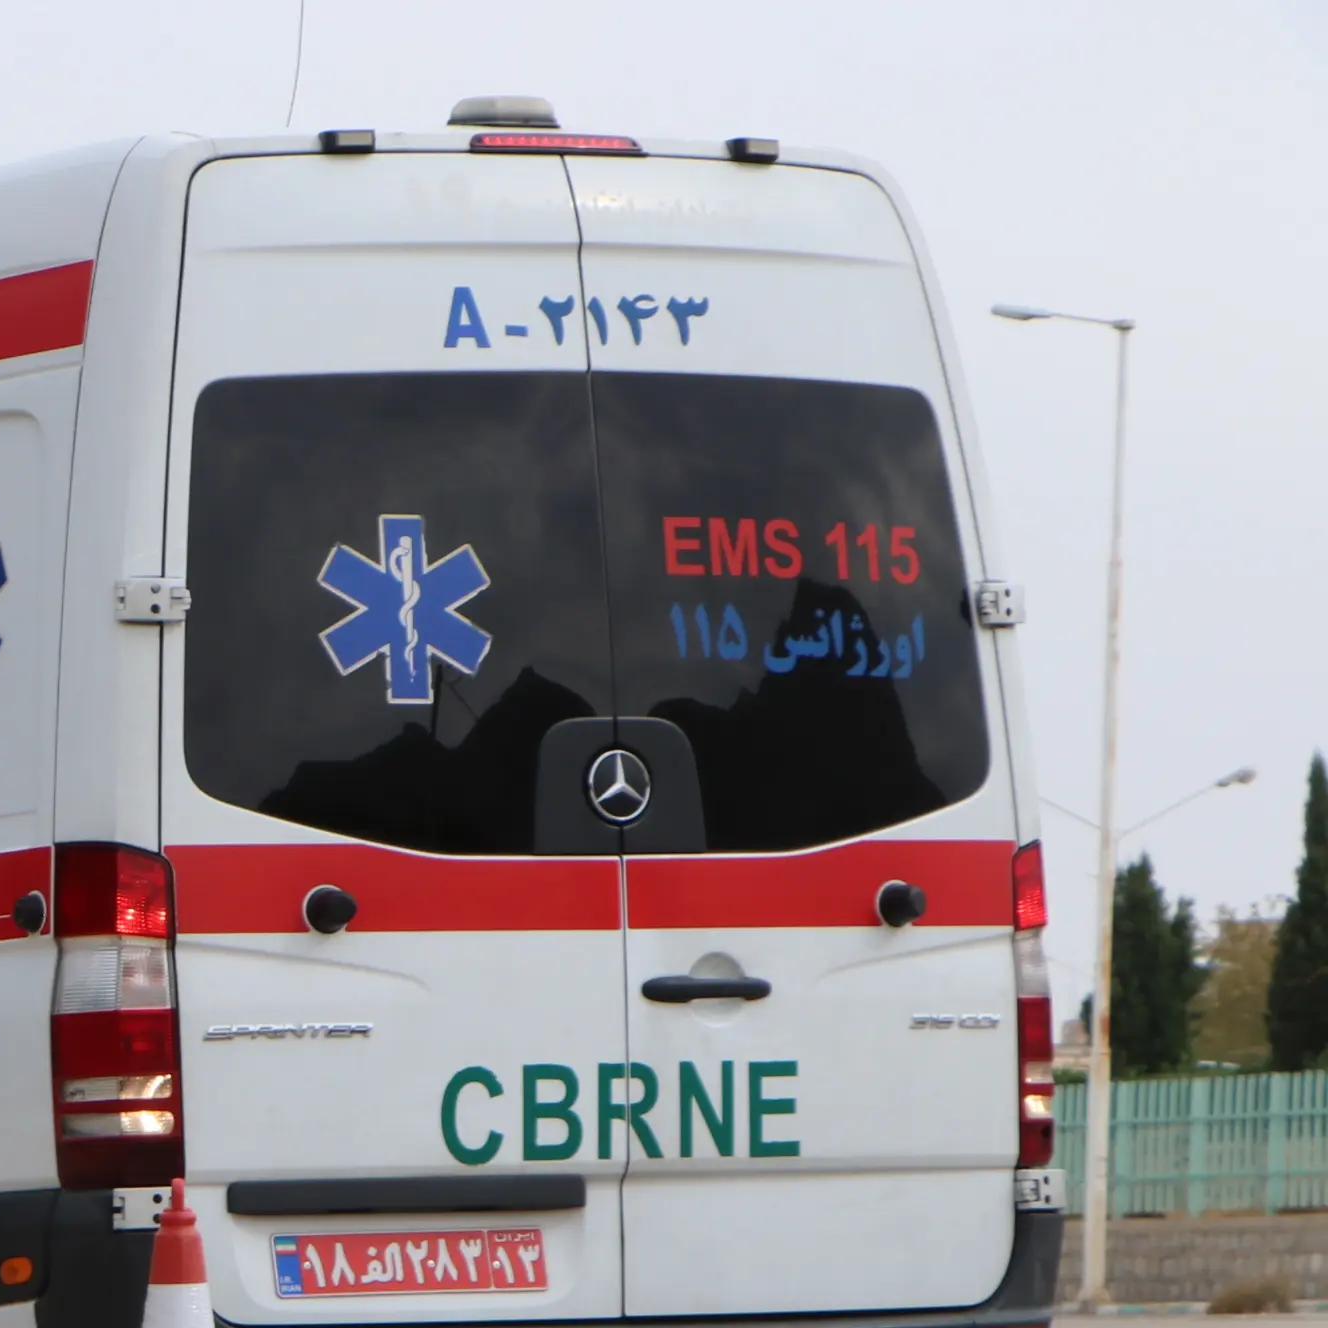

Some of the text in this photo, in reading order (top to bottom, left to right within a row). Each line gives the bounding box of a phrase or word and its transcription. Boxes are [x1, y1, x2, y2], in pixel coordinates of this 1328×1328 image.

[662, 516, 921, 584] EMS 115
[669, 602, 926, 679] اورژانس ۱۱۵
[440, 1060, 801, 1166] CBRNE
[493, 1231, 536, 1243] ایران
